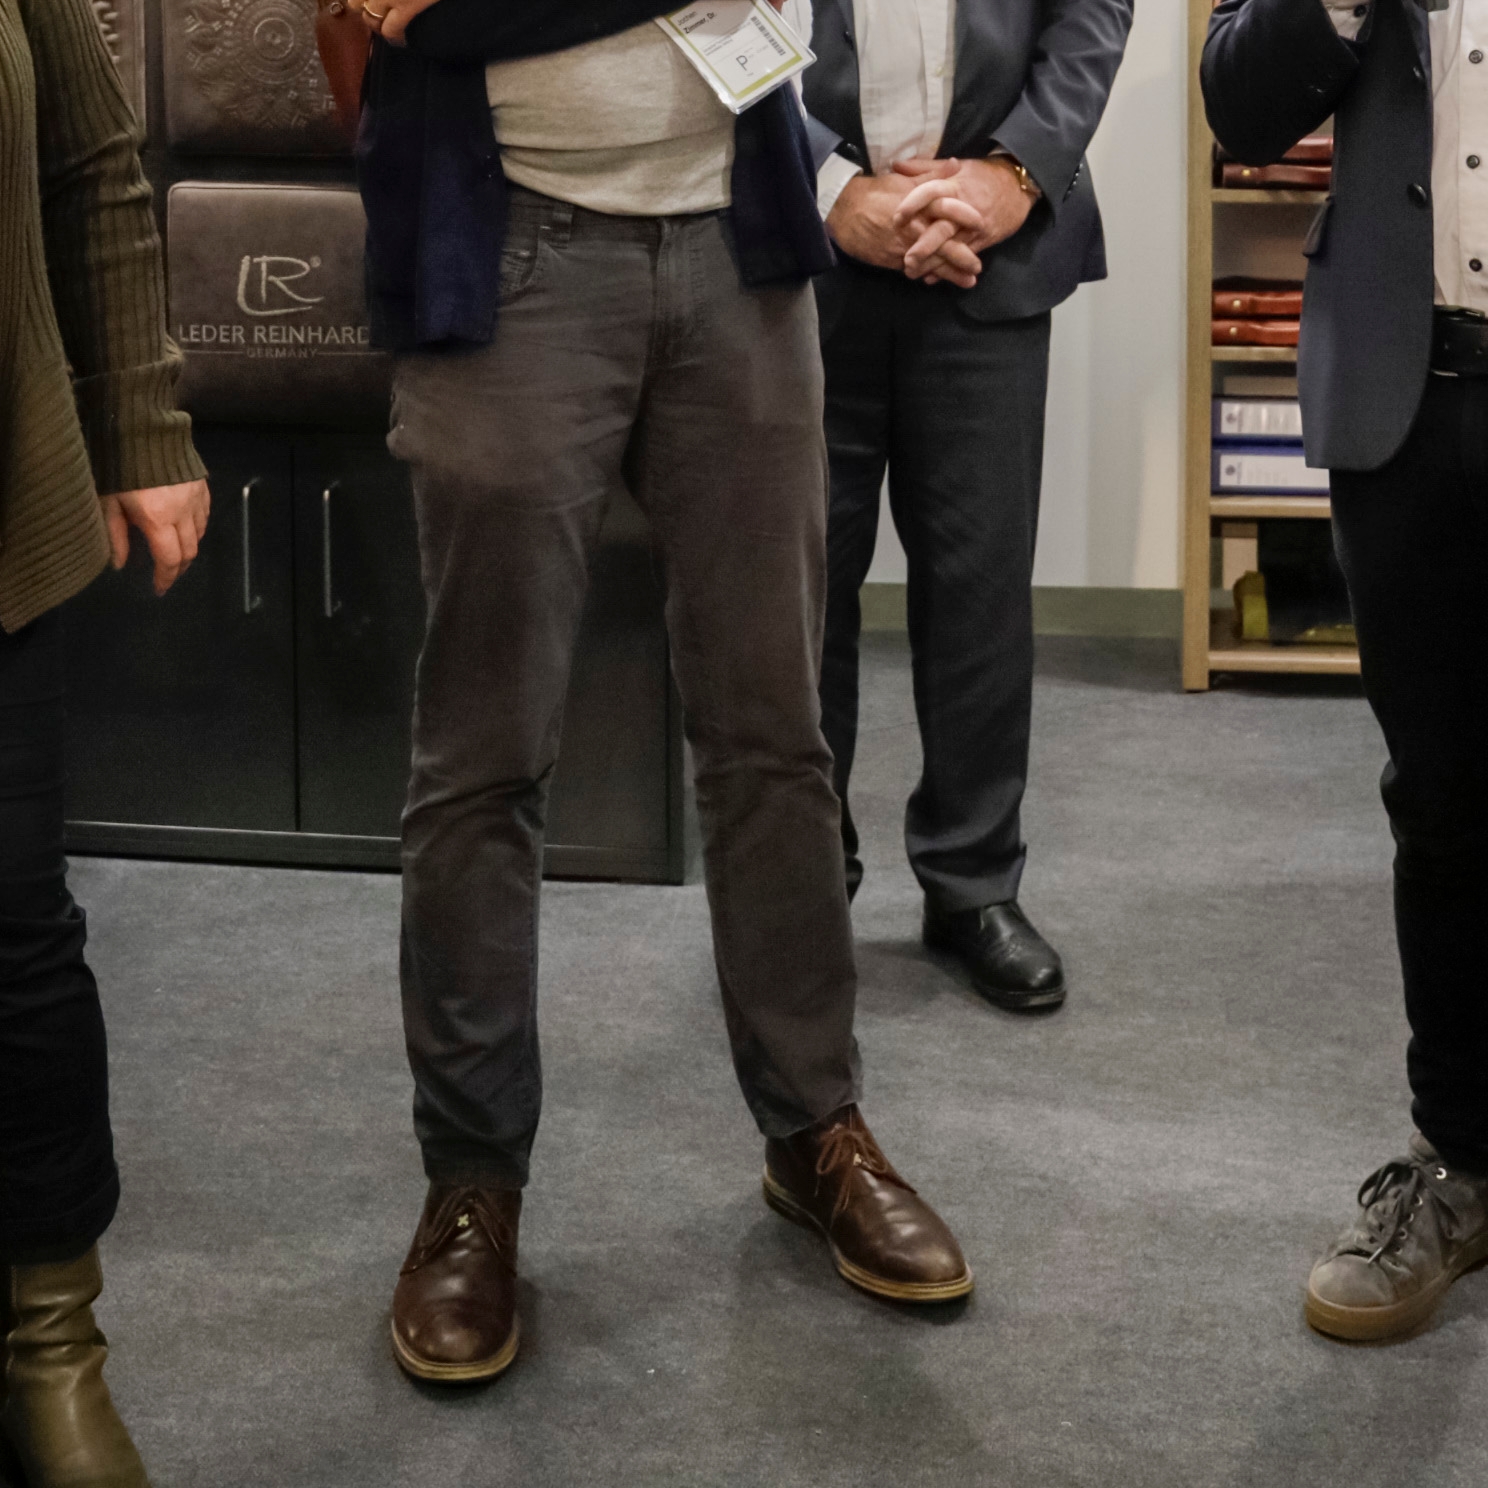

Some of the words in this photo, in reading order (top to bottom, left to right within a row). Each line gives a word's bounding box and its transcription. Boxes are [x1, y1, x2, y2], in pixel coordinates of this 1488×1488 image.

[736, 55, 748, 71] P
[179, 324, 246, 344] LEDER
[254, 325, 369, 345] REINHARD
[246, 347, 317, 359] GERMANY
